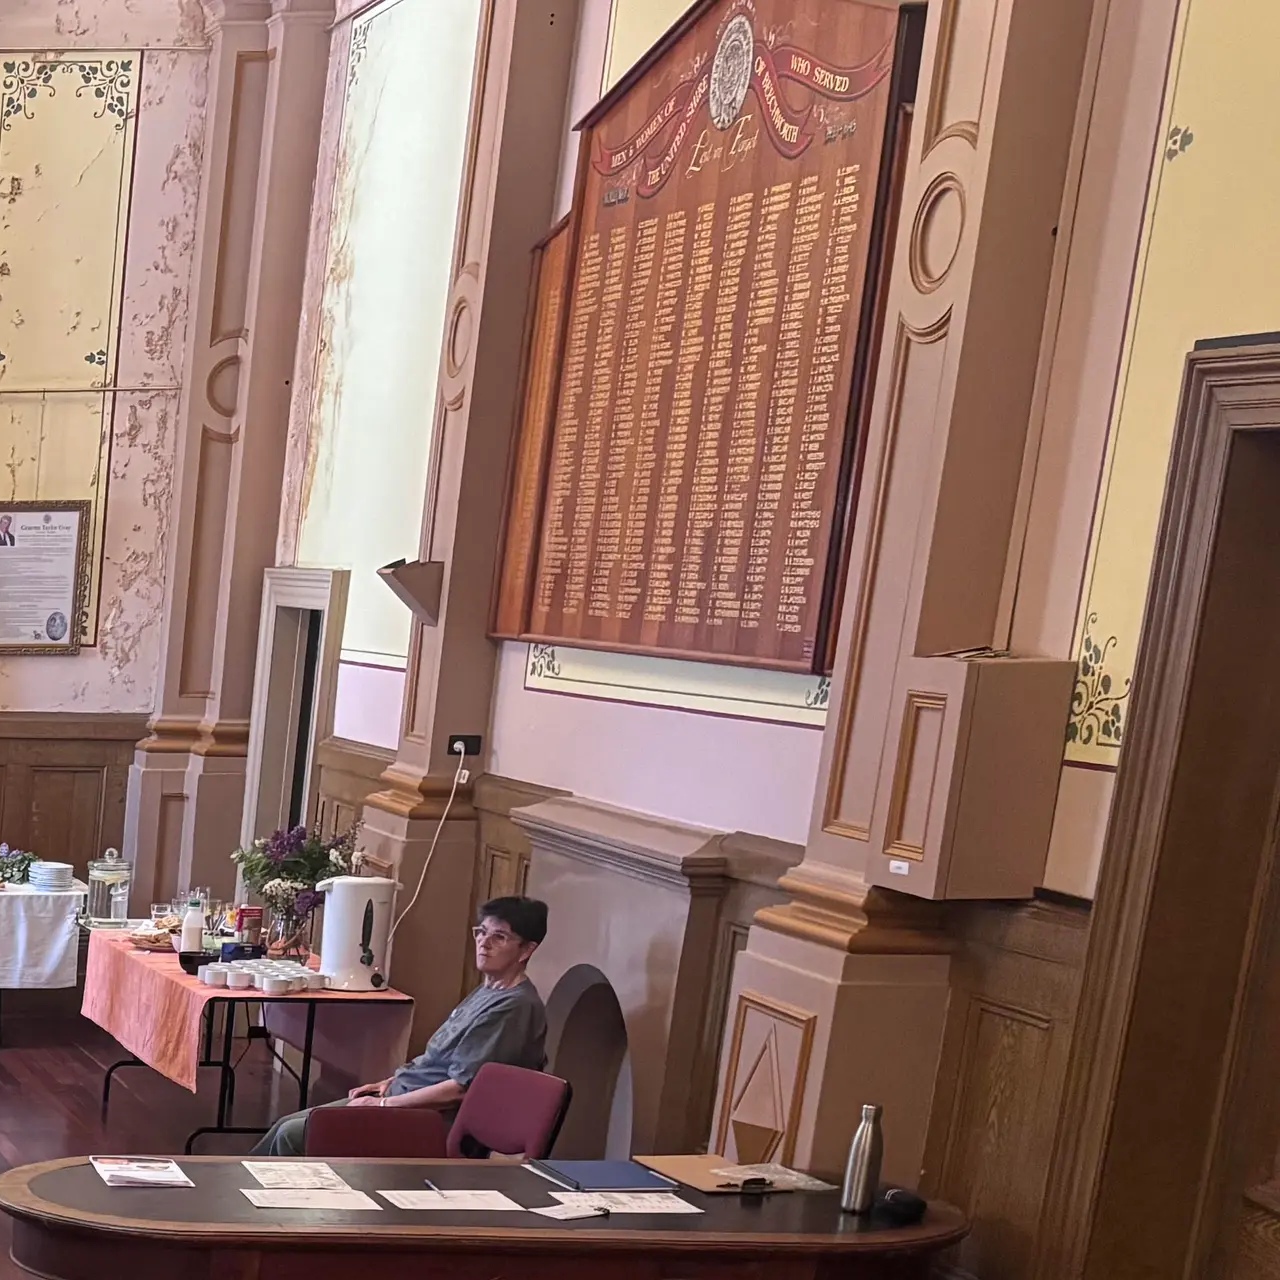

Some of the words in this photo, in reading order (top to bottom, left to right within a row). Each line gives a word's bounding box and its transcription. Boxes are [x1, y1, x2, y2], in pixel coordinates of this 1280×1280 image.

[790, 54, 811, 76] WHO
[813, 67, 850, 92] SERVED
[611, 149, 627, 168] MEN
[664, 96, 677, 117] OF
